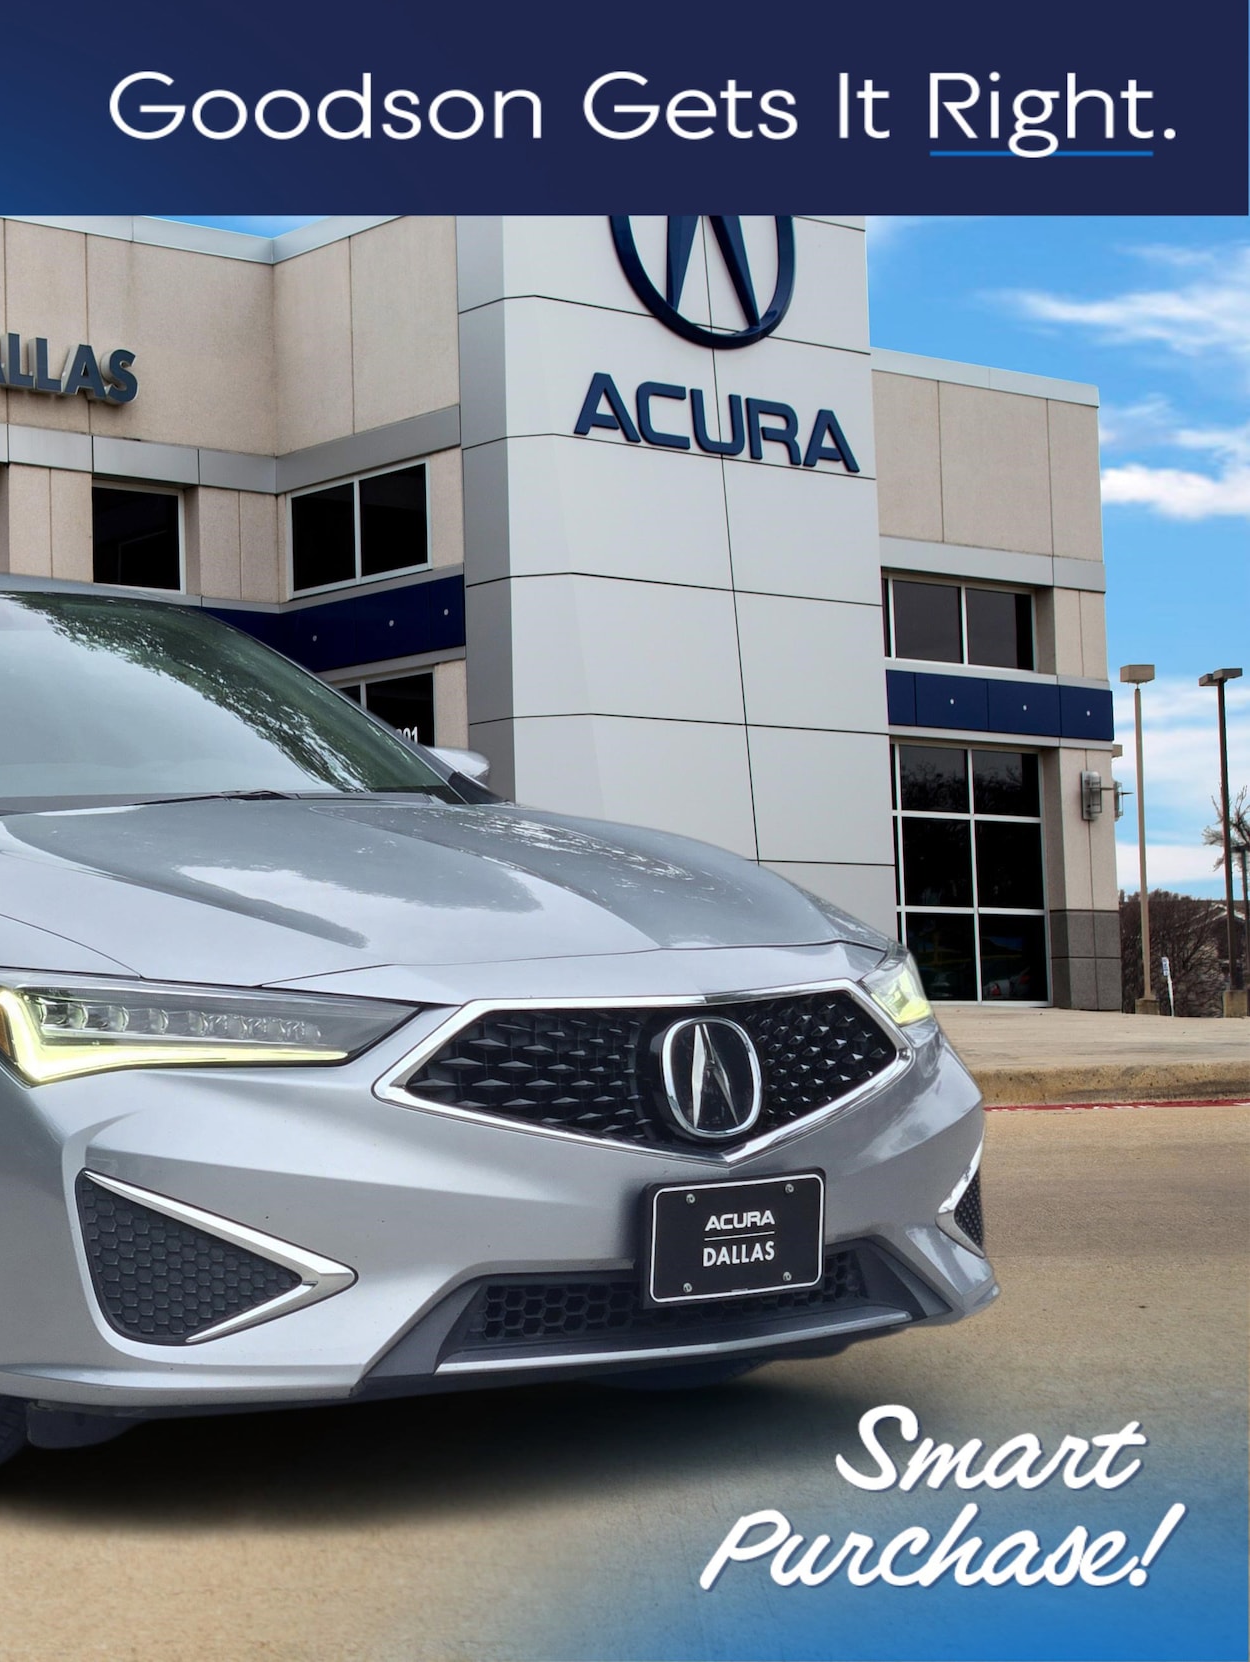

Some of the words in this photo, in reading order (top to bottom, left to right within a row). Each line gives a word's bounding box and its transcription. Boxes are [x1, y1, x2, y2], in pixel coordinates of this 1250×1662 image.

[573, 372, 860, 473] ACURA
[705, 1210, 776, 1231] ACURA
[703, 1241, 775, 1267] DALLAS
